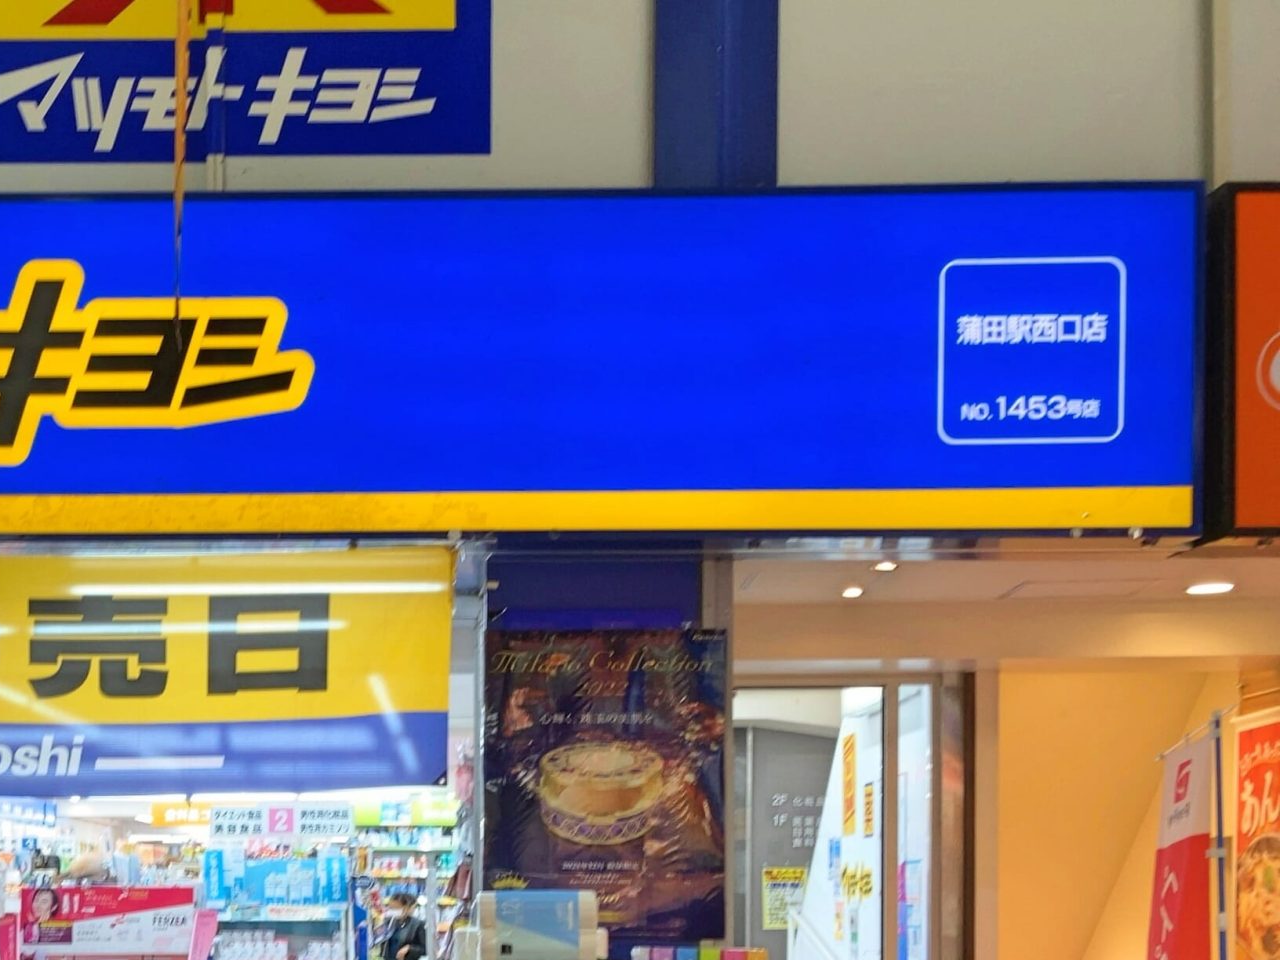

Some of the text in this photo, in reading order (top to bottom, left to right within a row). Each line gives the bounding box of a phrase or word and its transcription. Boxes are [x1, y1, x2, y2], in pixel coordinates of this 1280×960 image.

[956, 312, 1109, 345] 蒲田駅西口店
[588, 645, 714, 673] Collection
[274, 810, 289, 833] 2
